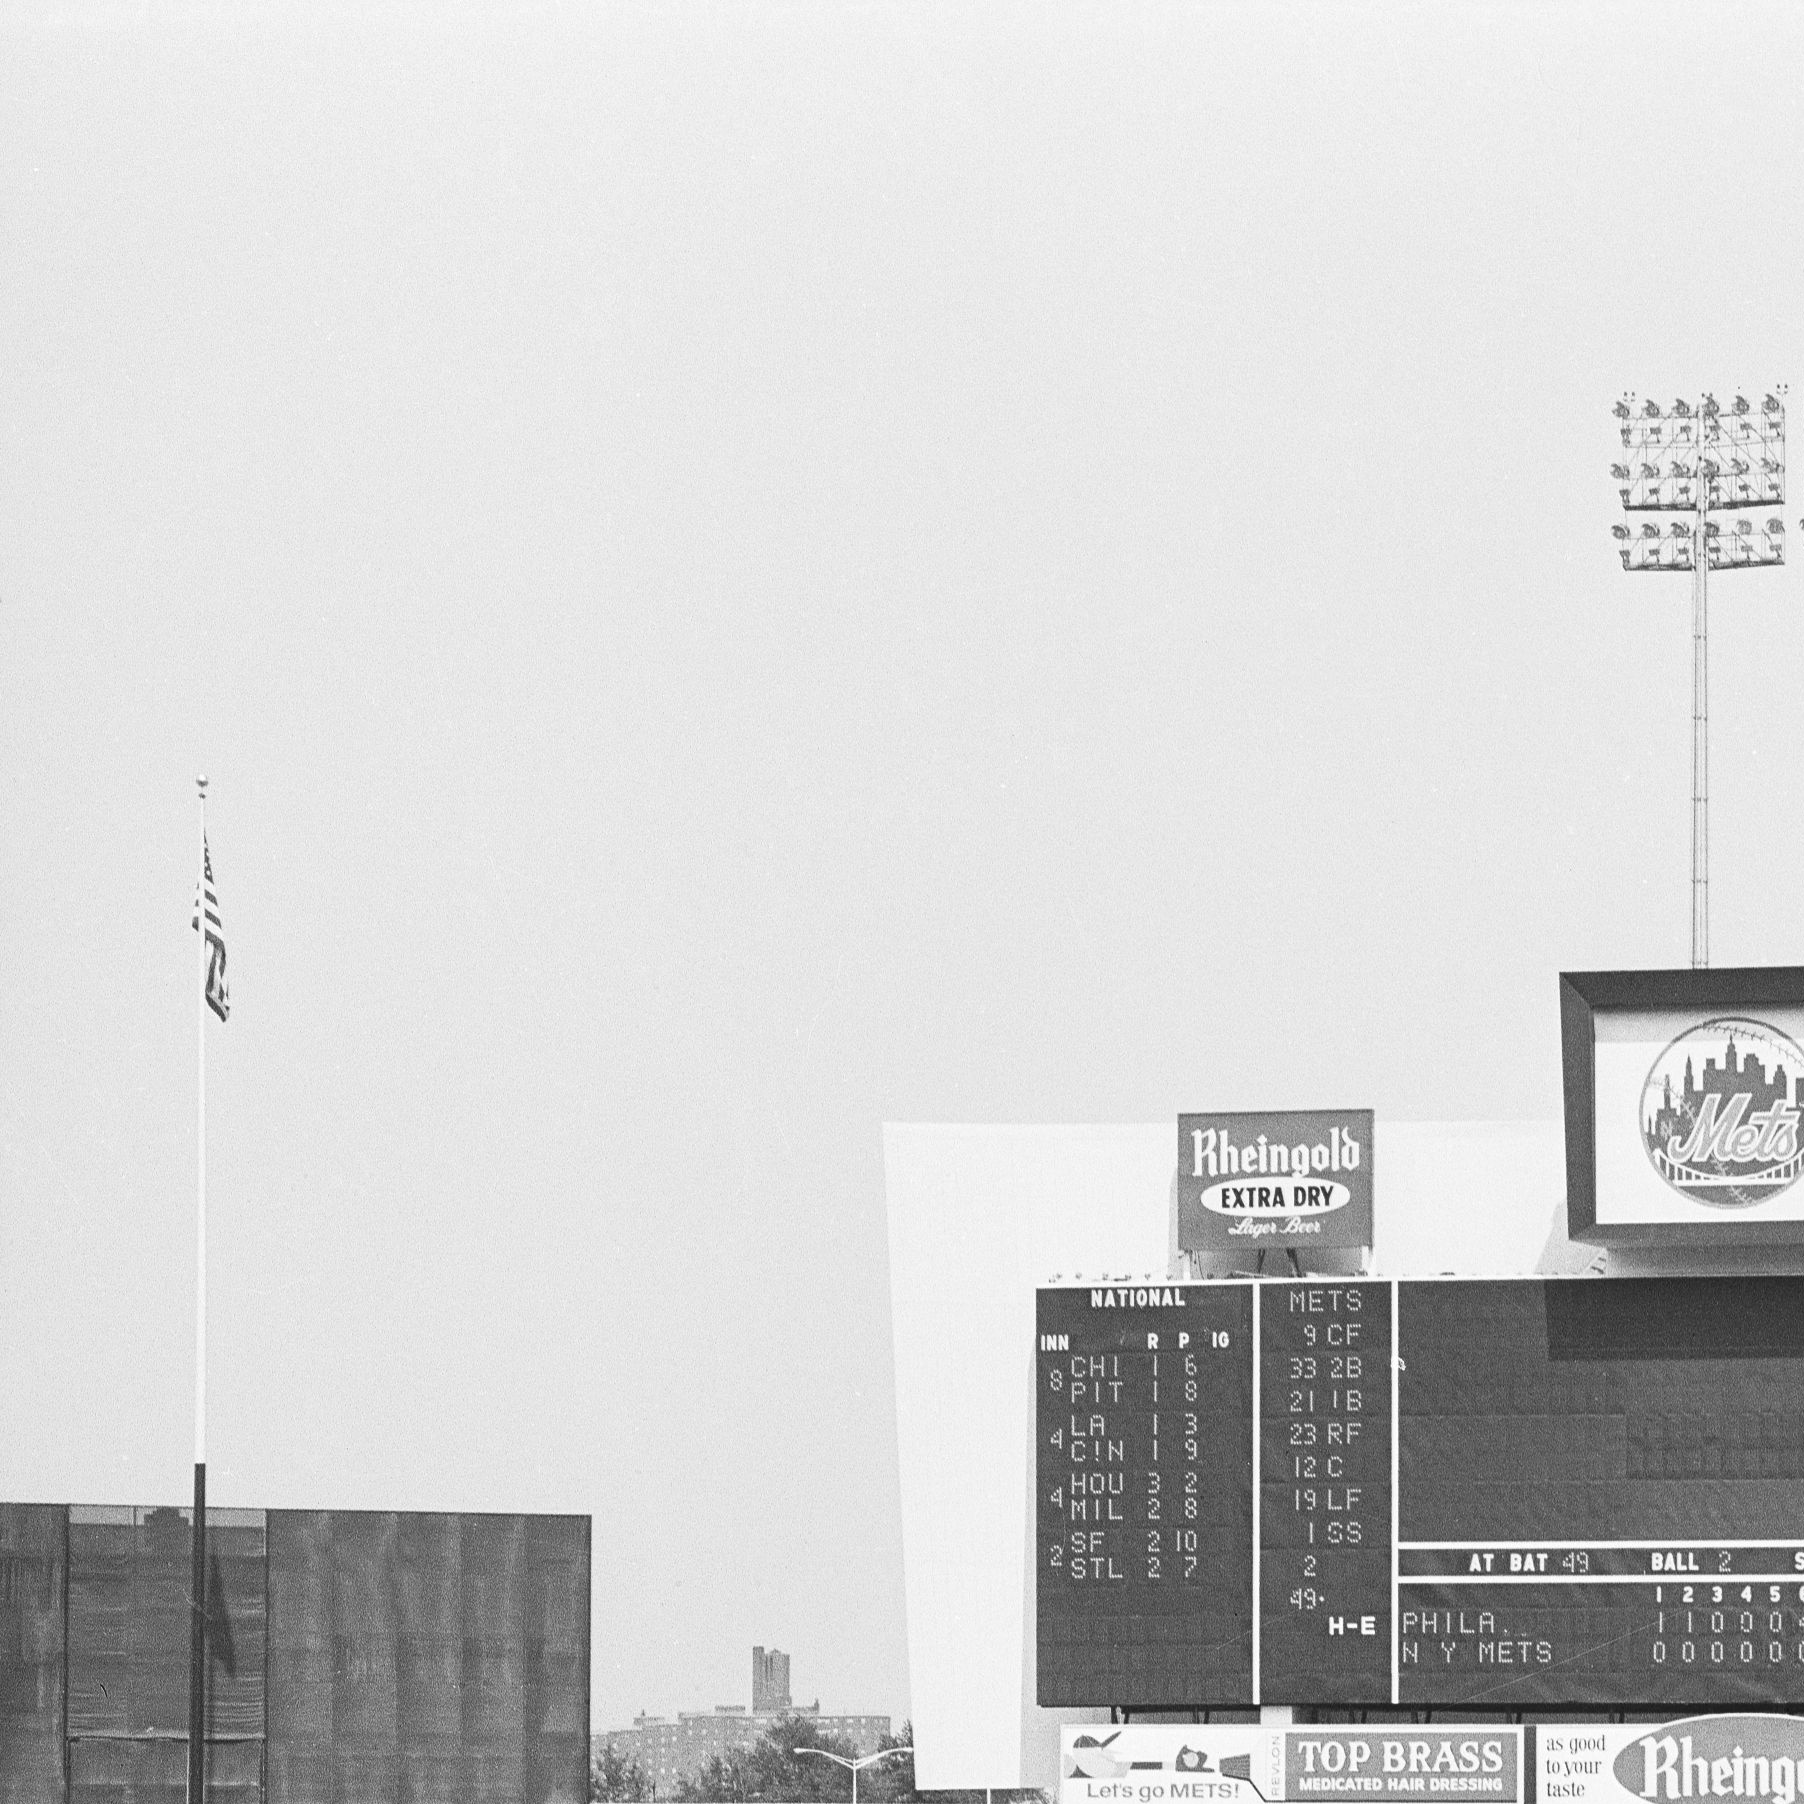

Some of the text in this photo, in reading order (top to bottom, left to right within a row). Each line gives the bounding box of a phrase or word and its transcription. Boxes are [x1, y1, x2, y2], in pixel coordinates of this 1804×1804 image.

[1667, 1093, 1800, 1162] Mets
[1191, 1126, 1359, 1177] Rheingold
[1222, 1186, 1333, 1209] EXTRA DRY
[1280, 1217, 1320, 1233] Beer
[1091, 1287, 1186, 1308] NATIONAL
[1290, 1289, 1362, 1313] METS
[1040, 1331, 1190, 1351] INN R P
[1327, 1323, 1362, 1346] CF
[1071, 1355, 1118, 1378] CHI
[1290, 1356, 1362, 1379] 33 2B
[1071, 1381, 1124, 1404] PIT
[1290, 1389, 1362, 1412] 21 1B
[1071, 1414, 1105, 1437] LA
[1290, 1422, 1362, 1445] 23 RF
[1295, 1455, 1343, 1478] 12 C
[1071, 1472, 1124, 1495] HOU
[1071, 1498, 1123, 1521] MIL
[1295, 1488, 1362, 1511] 19 LF
[1071, 1530, 1197, 1554] SF 10
[1327, 1521, 1362, 1544] SS
[1071, 1557, 1123, 1579] STL
[1469, 1551, 1589, 1573] AT BAT 49
[1651, 1550, 1731, 1573] BALL 2
[1328, 1615, 1376, 1636] H-E
[1402, 1641, 1552, 1664] N Y METS
[1299, 1740, 1503, 1773] TOP BRASS
[1546, 1735, 1606, 1755] as good
[1270, 1736, 1280, 1797] REVLON
[1546, 1760, 1602, 1778] to your
[1087, 1783, 1239, 1804] Let's go METS!
[1299, 1778, 1502, 1791] MEDICATED HAIR DRESSING
[1546, 1783, 1584, 1798] taste
